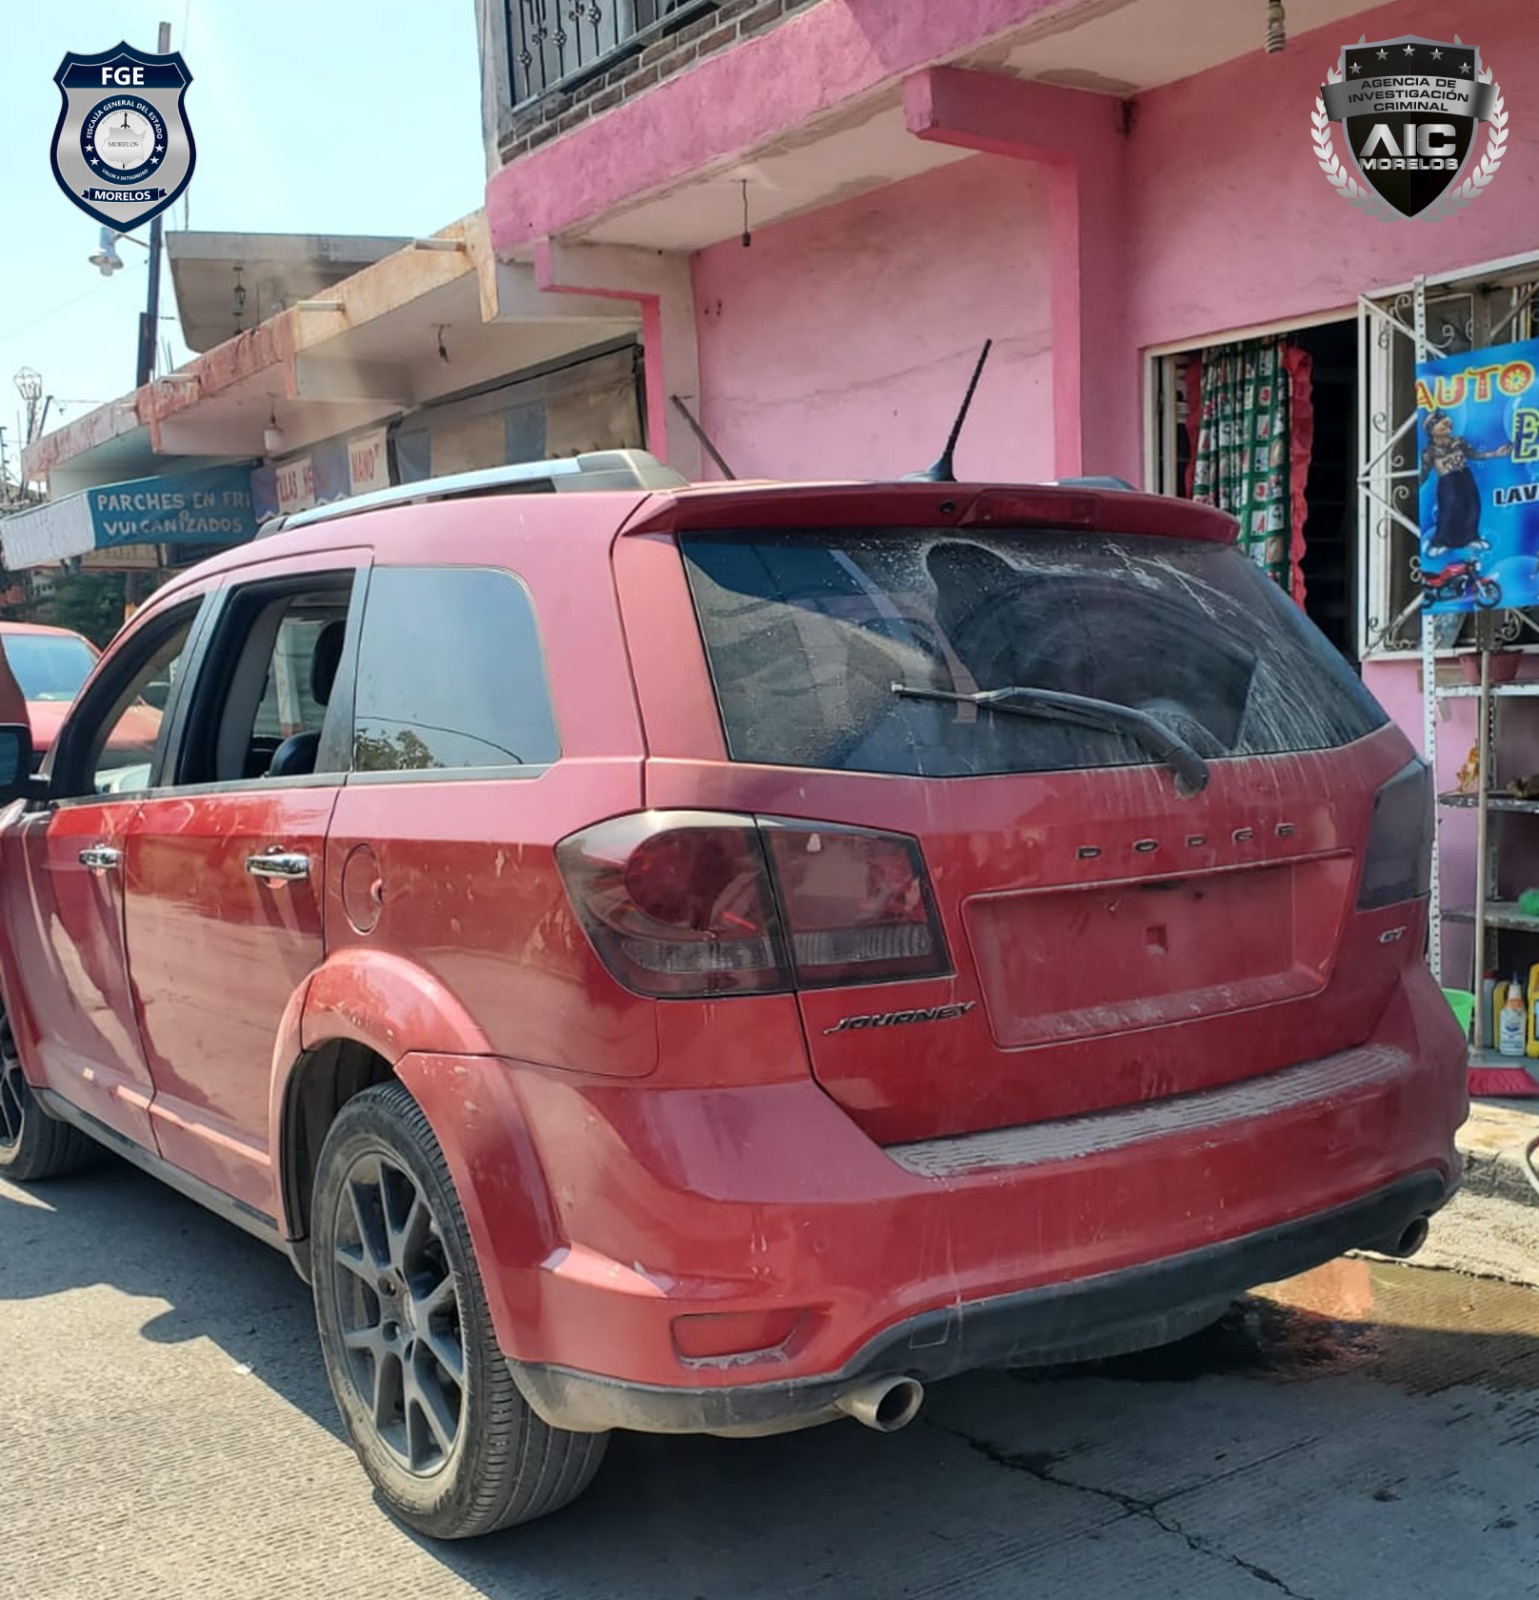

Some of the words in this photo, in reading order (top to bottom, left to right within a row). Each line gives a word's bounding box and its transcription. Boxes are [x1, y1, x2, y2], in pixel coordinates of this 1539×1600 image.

[1415, 360, 1535, 411] AUTO
[97, 492, 185, 512] PARCHES
[193, 492, 216, 509] EN
[103, 517, 243, 536] VULCANIZADOS
[1076, 822, 1295, 859] DODGE
[1379, 925, 1408, 944] GT
[822, 1001, 976, 1035] JOURNEY
